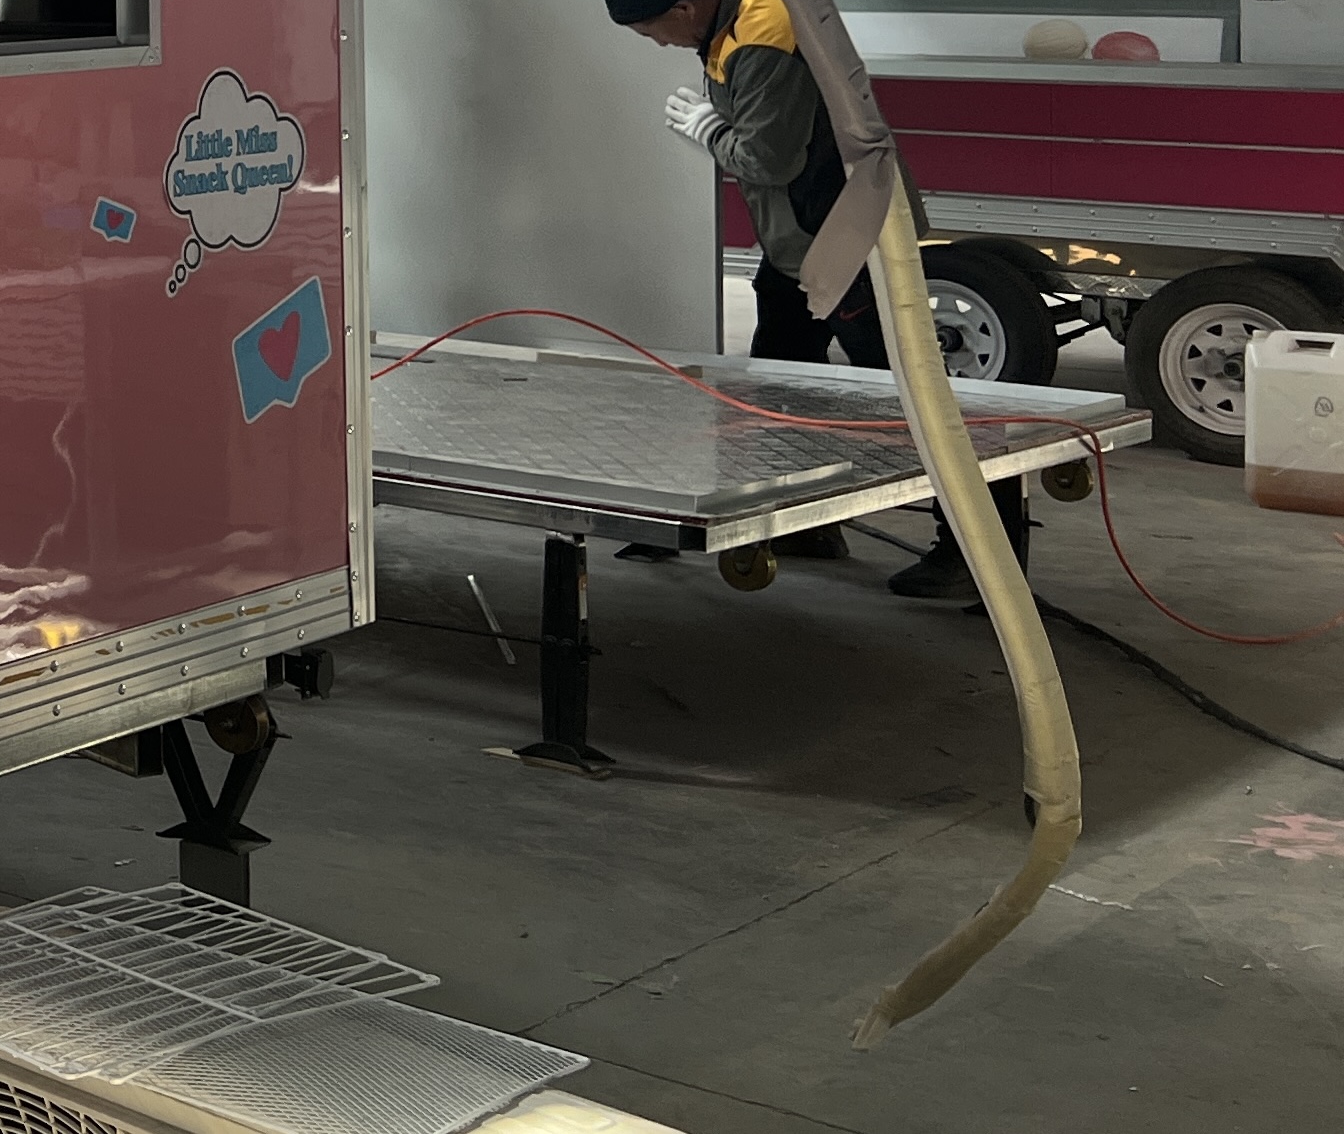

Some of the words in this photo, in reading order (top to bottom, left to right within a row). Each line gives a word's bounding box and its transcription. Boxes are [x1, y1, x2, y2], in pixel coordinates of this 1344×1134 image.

[184, 129, 233, 162] Little
[235, 125, 278, 156] Miss
[173, 162, 229, 198] Snack
[232, 154, 294, 195] Queen!
